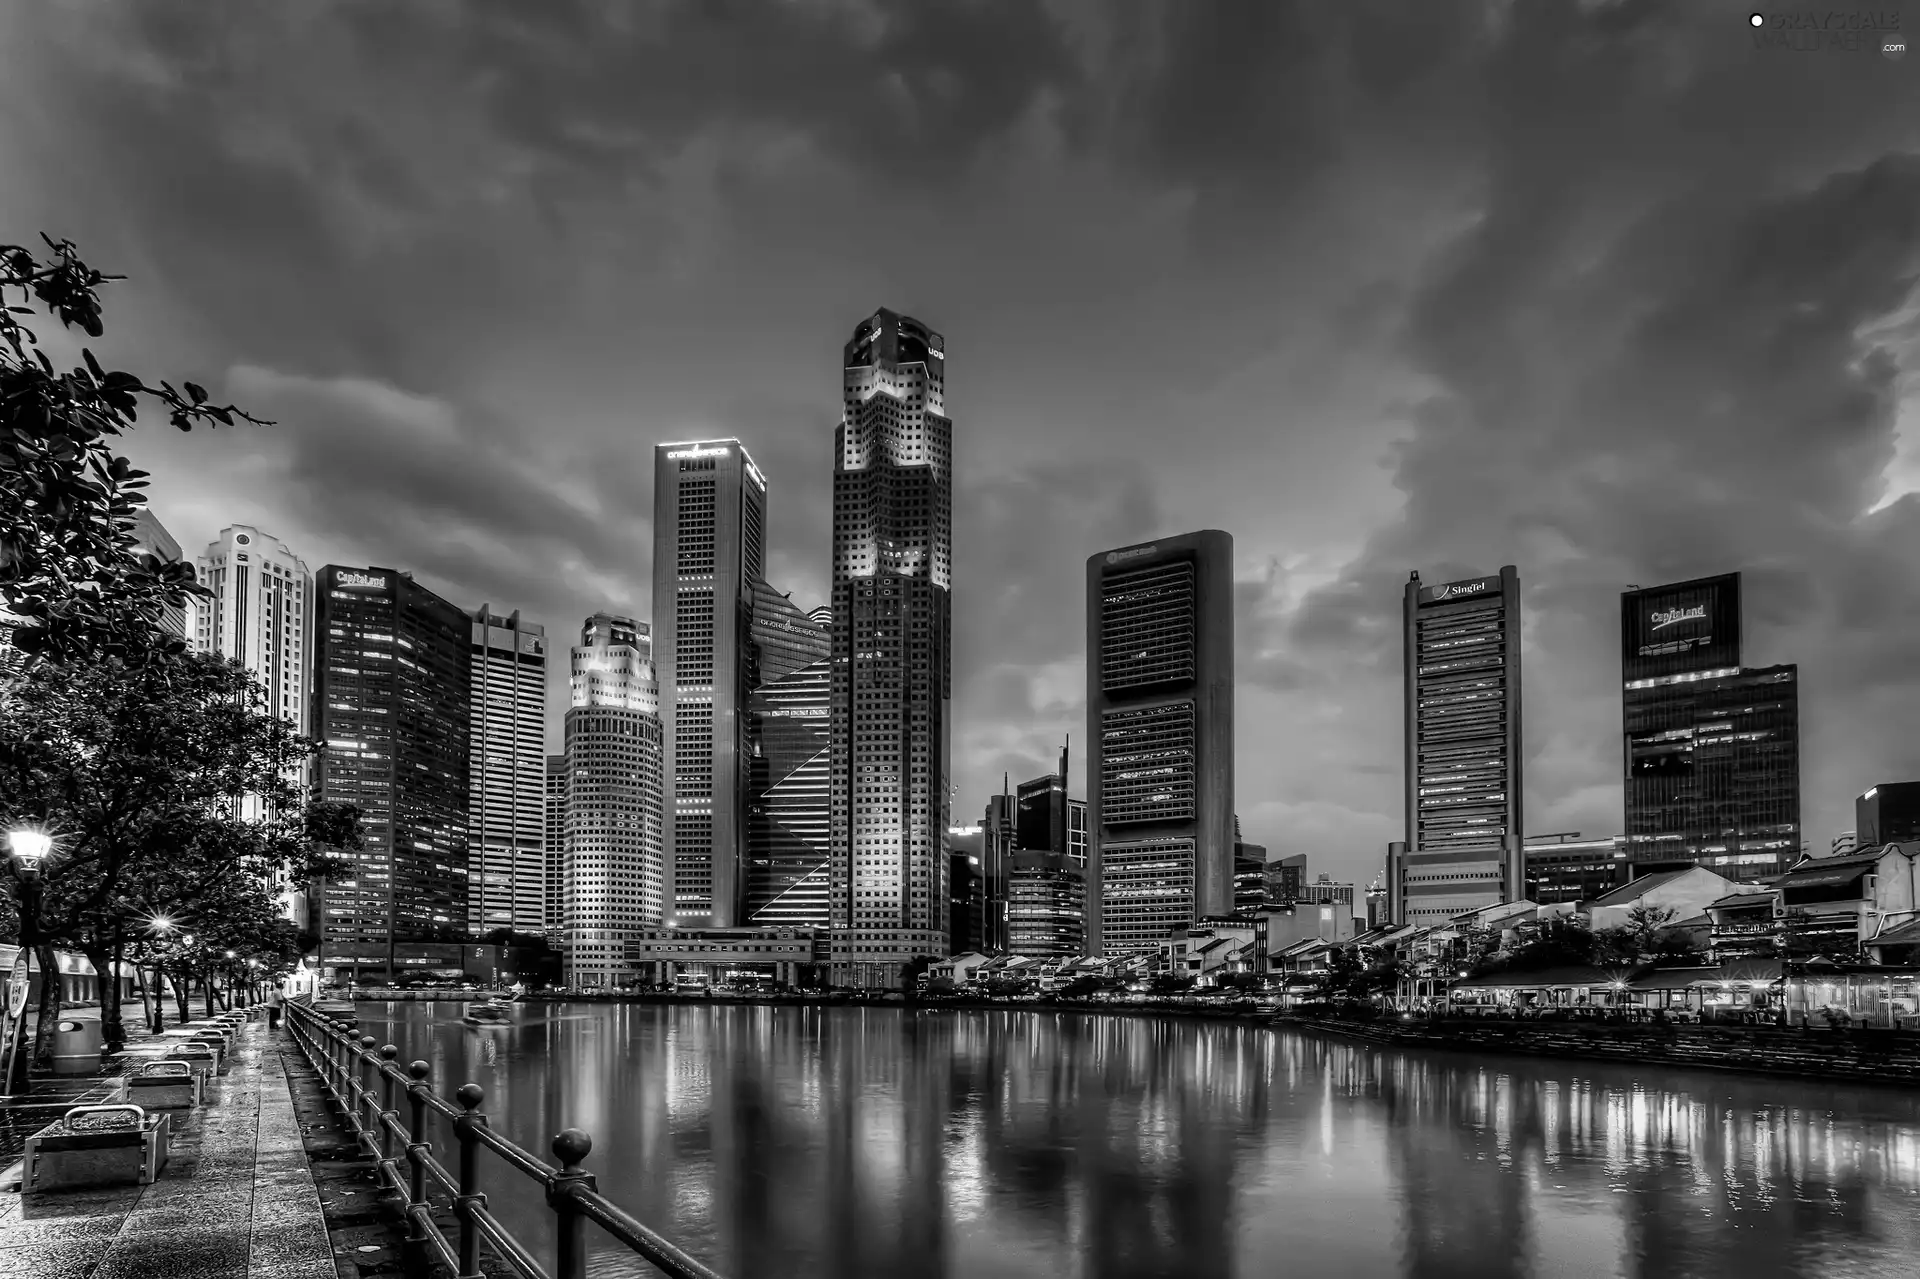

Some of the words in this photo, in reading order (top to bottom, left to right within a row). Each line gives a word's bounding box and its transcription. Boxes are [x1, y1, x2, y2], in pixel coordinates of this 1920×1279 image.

[928, 347, 944, 360] UOB
[336, 571, 386, 587] CapitaLand
[1452, 582, 1485, 595] SingTel
[1651, 604, 1704, 624] CapitaLand
